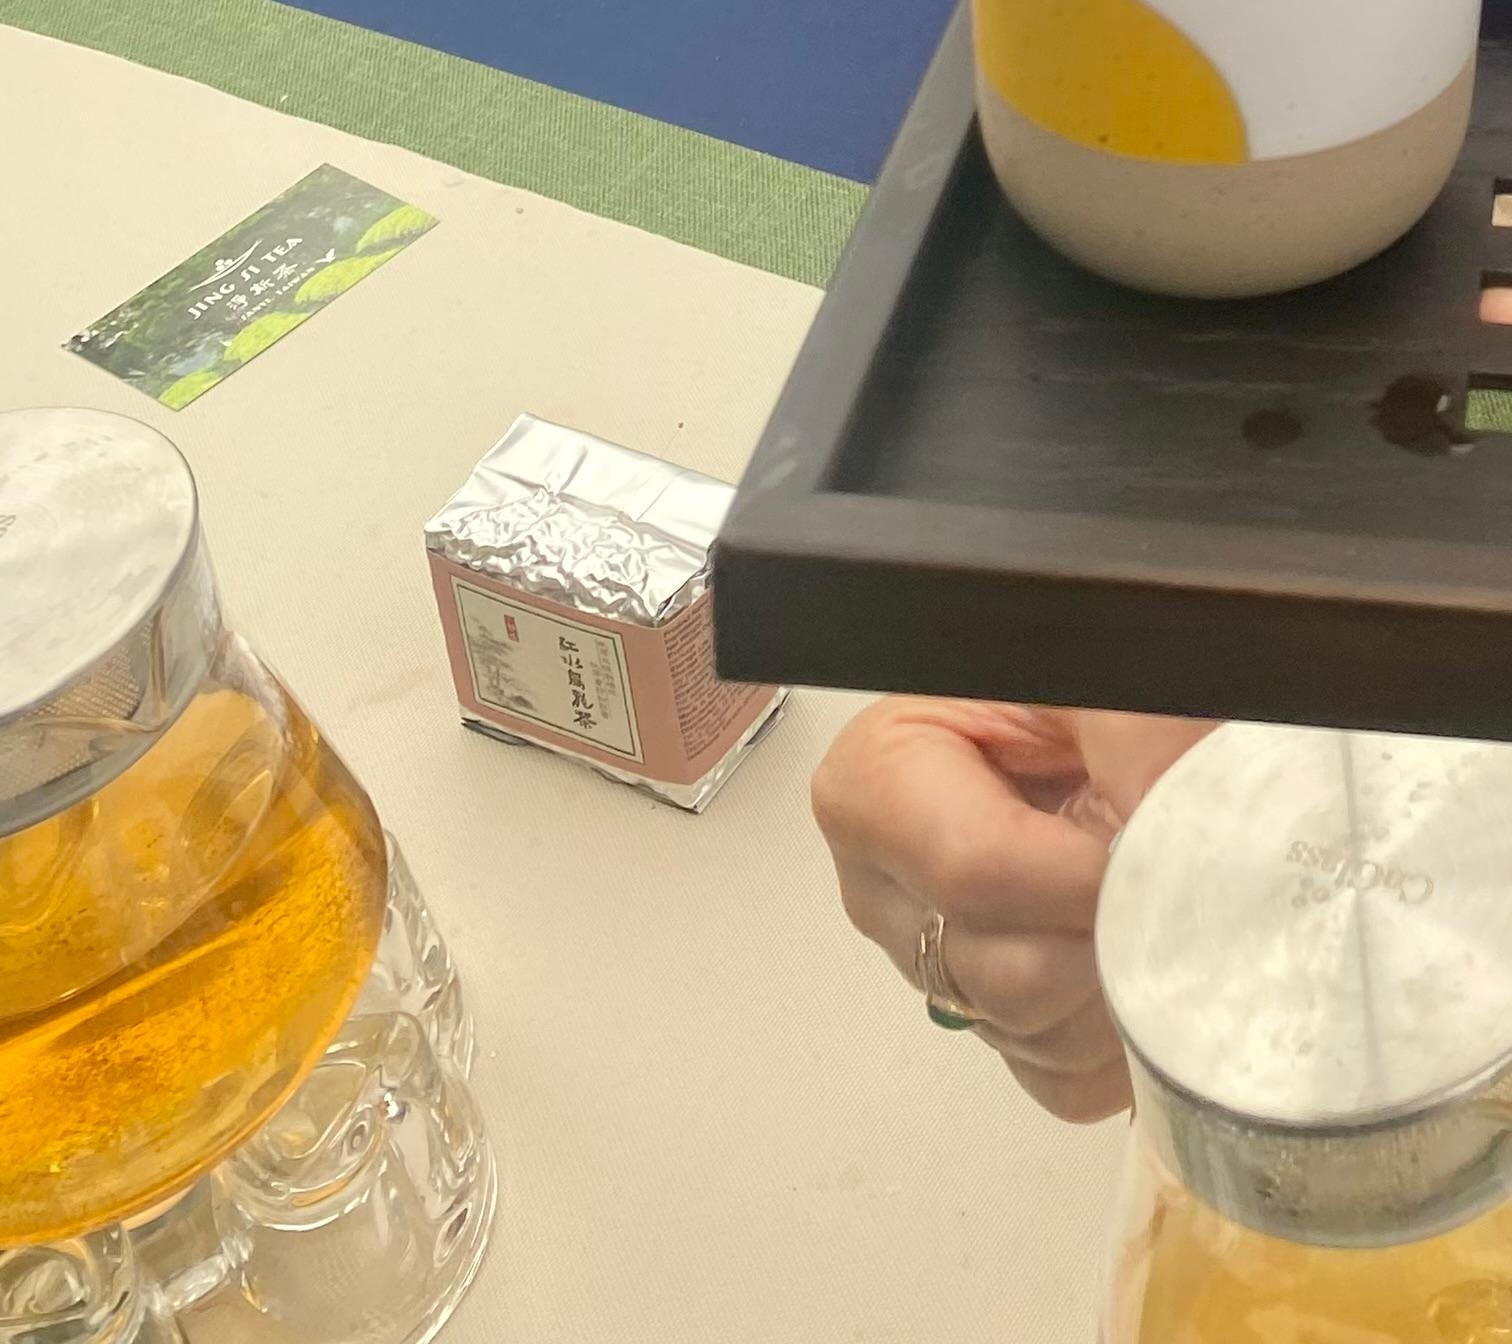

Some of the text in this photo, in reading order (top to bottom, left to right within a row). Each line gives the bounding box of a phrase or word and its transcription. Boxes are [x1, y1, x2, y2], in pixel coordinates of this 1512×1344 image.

[187, 237, 304, 320] JING SI TEA
